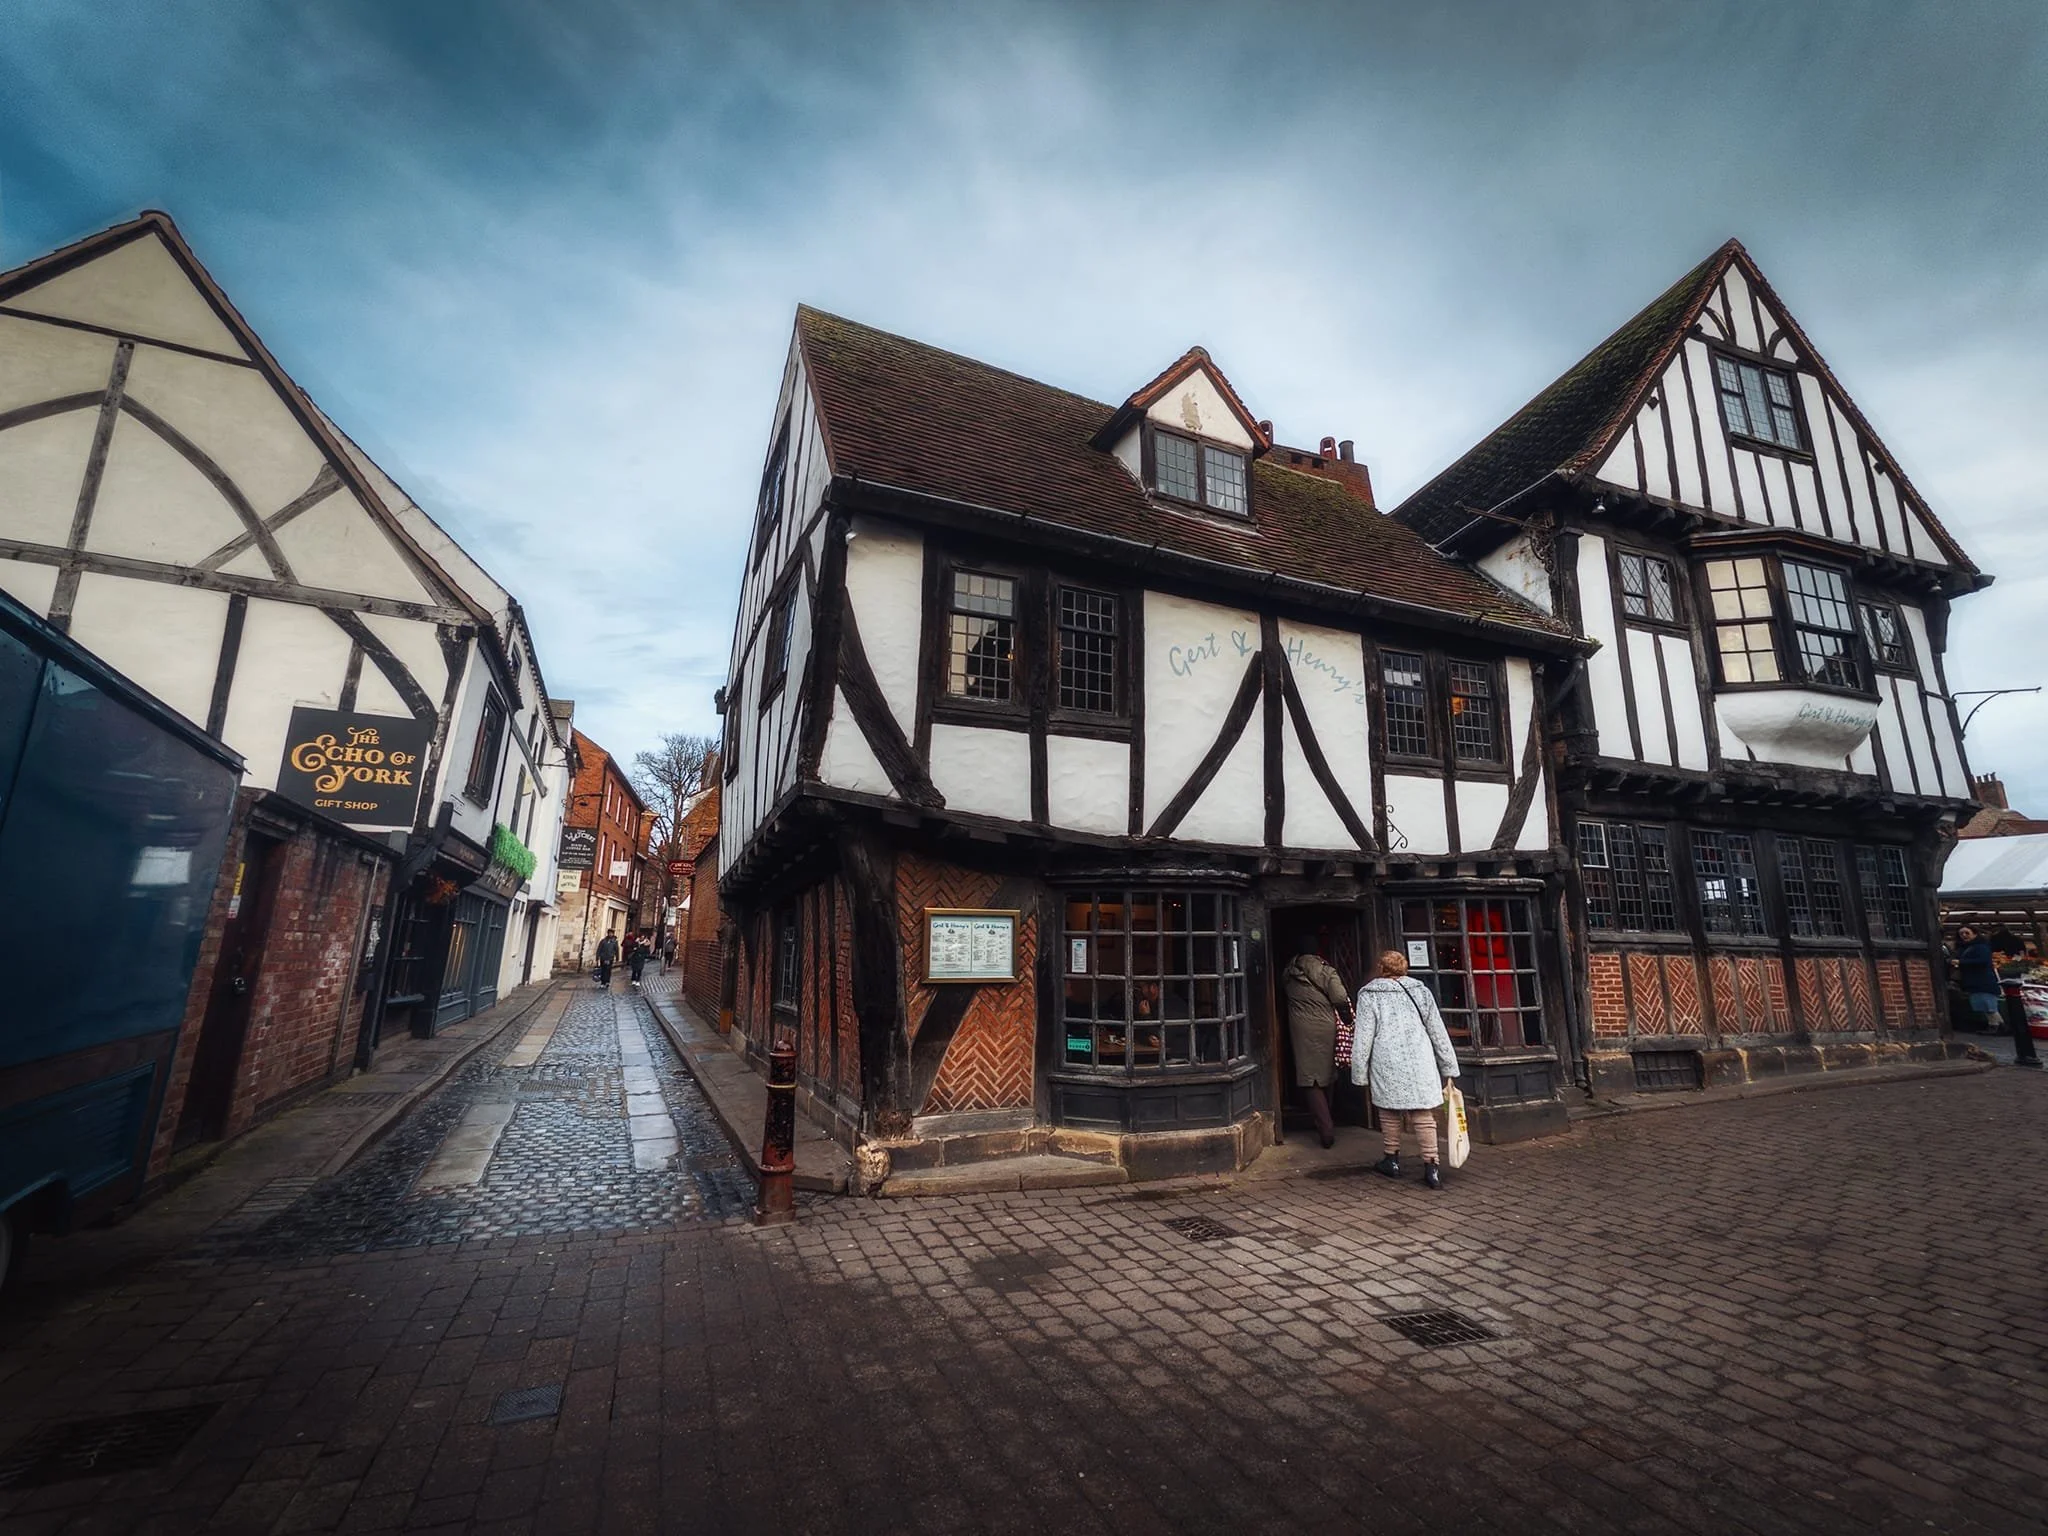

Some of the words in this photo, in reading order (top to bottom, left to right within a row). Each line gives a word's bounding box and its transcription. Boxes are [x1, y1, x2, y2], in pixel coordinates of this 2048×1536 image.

[1168, 632, 1220, 677] Gert
[1231, 630, 1252, 657] &
[1287, 637, 1364, 704] Henry's
[1798, 702, 1824, 720] Gert
[1824, 705, 1834, 722] &
[346, 726, 380, 747] THE
[291, 734, 385, 773] ECHO
[389, 751, 417, 766] OF
[315, 764, 413, 793] YORK
[314, 799, 343, 808] GIFT
[344, 801, 378, 810] SHOP
